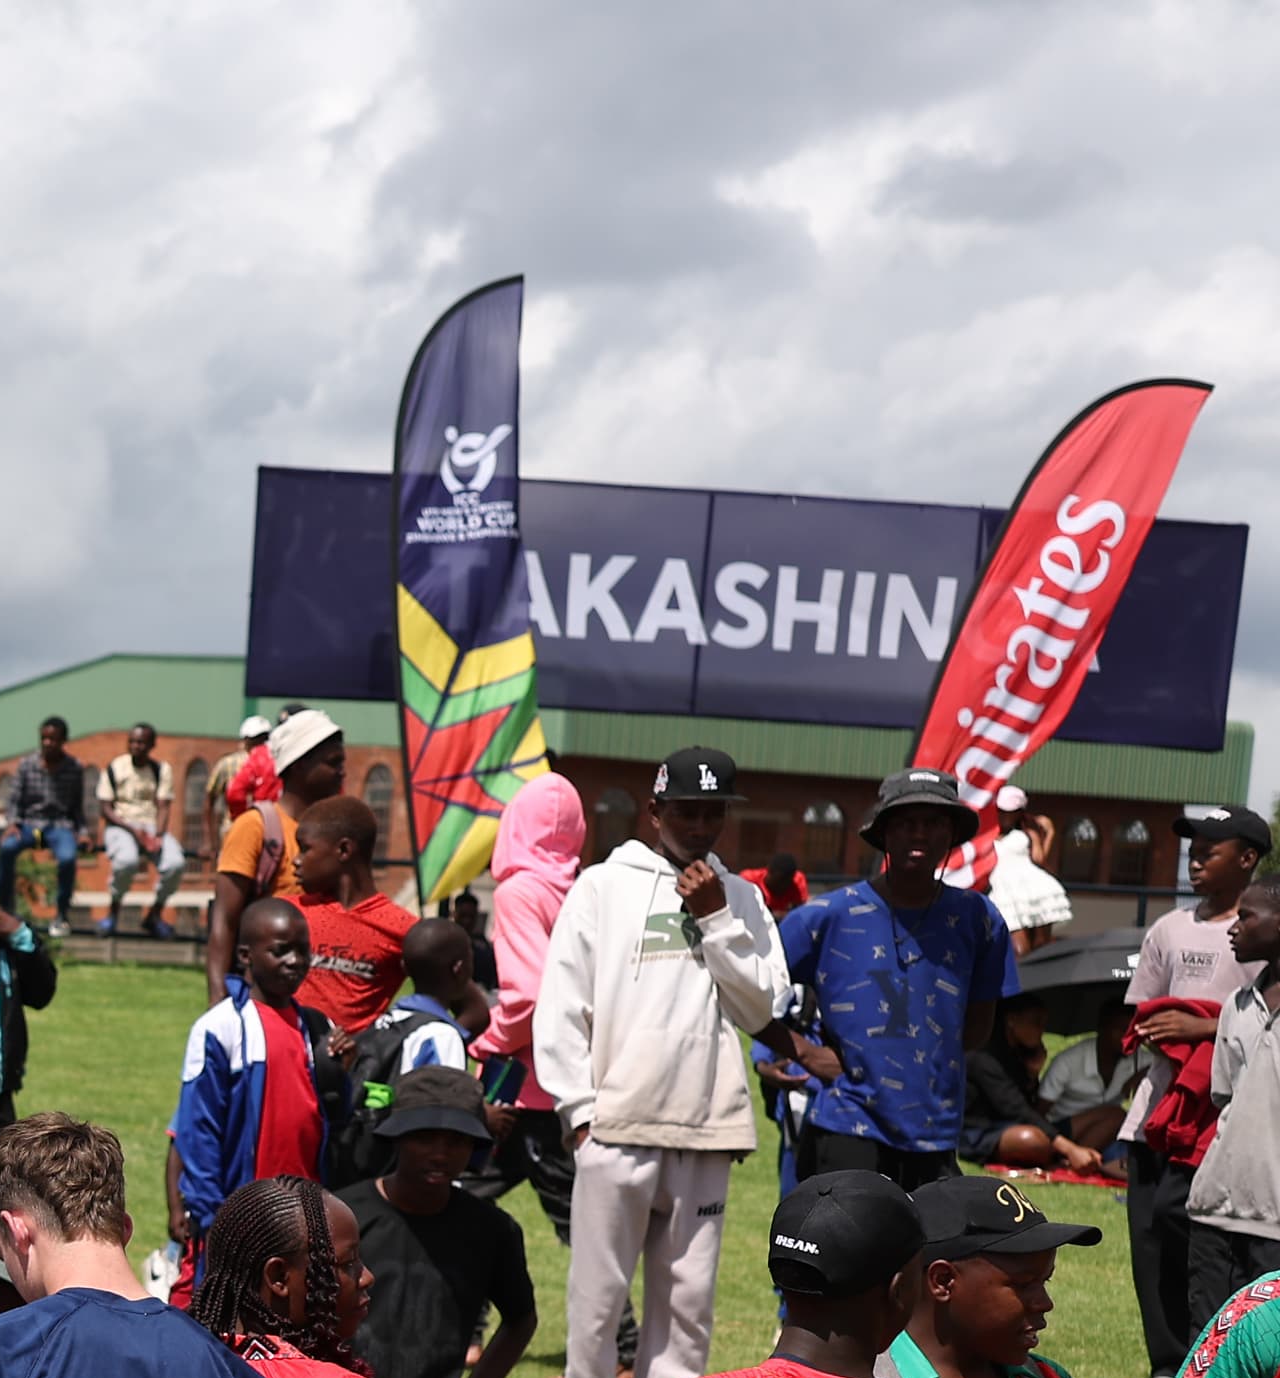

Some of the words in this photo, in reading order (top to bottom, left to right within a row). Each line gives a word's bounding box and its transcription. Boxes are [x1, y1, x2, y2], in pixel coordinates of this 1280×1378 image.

[417, 516, 482, 533] WORLD
[698, 764, 718, 790] LA
[1181, 950, 1216, 966] VANS
